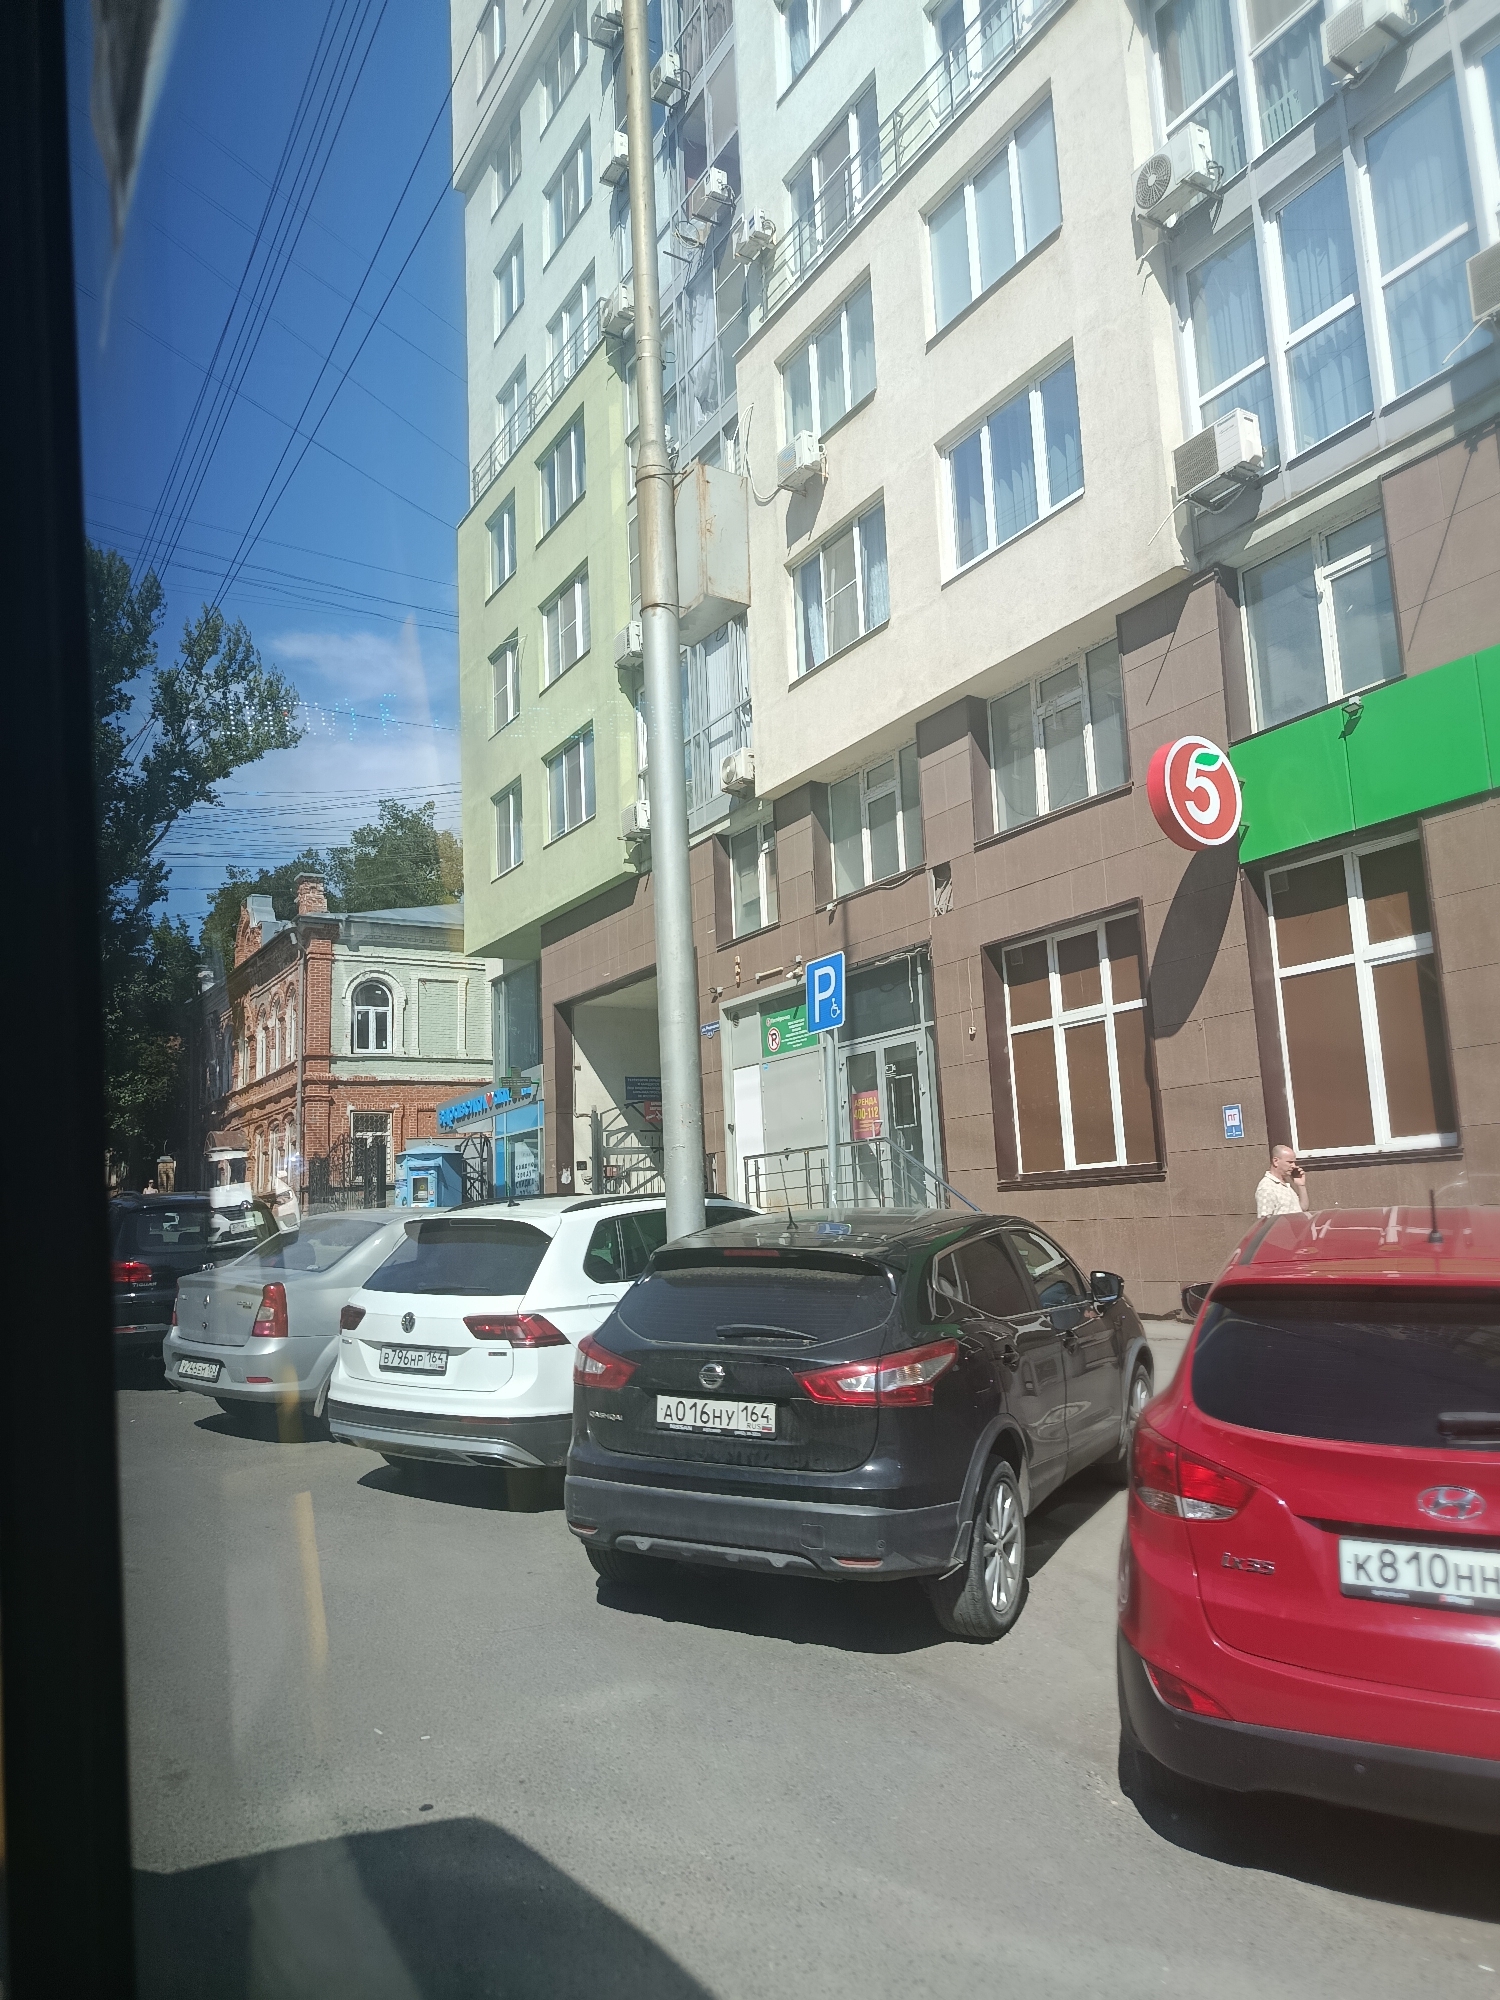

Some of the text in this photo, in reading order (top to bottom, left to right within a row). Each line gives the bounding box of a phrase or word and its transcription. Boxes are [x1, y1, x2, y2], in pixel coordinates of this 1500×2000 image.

[1185, 748, 1224, 825] 5
[814, 966, 836, 1023] P
[854, 1097, 877, 1107] АРЕНДА
[854, 1106, 879, 1120] 400-112
[1227, 1113, 1237, 1122] ПГ
[383, 1349, 443, 1367] В796НР 164
[663, 1401, 770, 1427] А016НУ 164
[1353, 1548, 1500, 1594] К810НН
